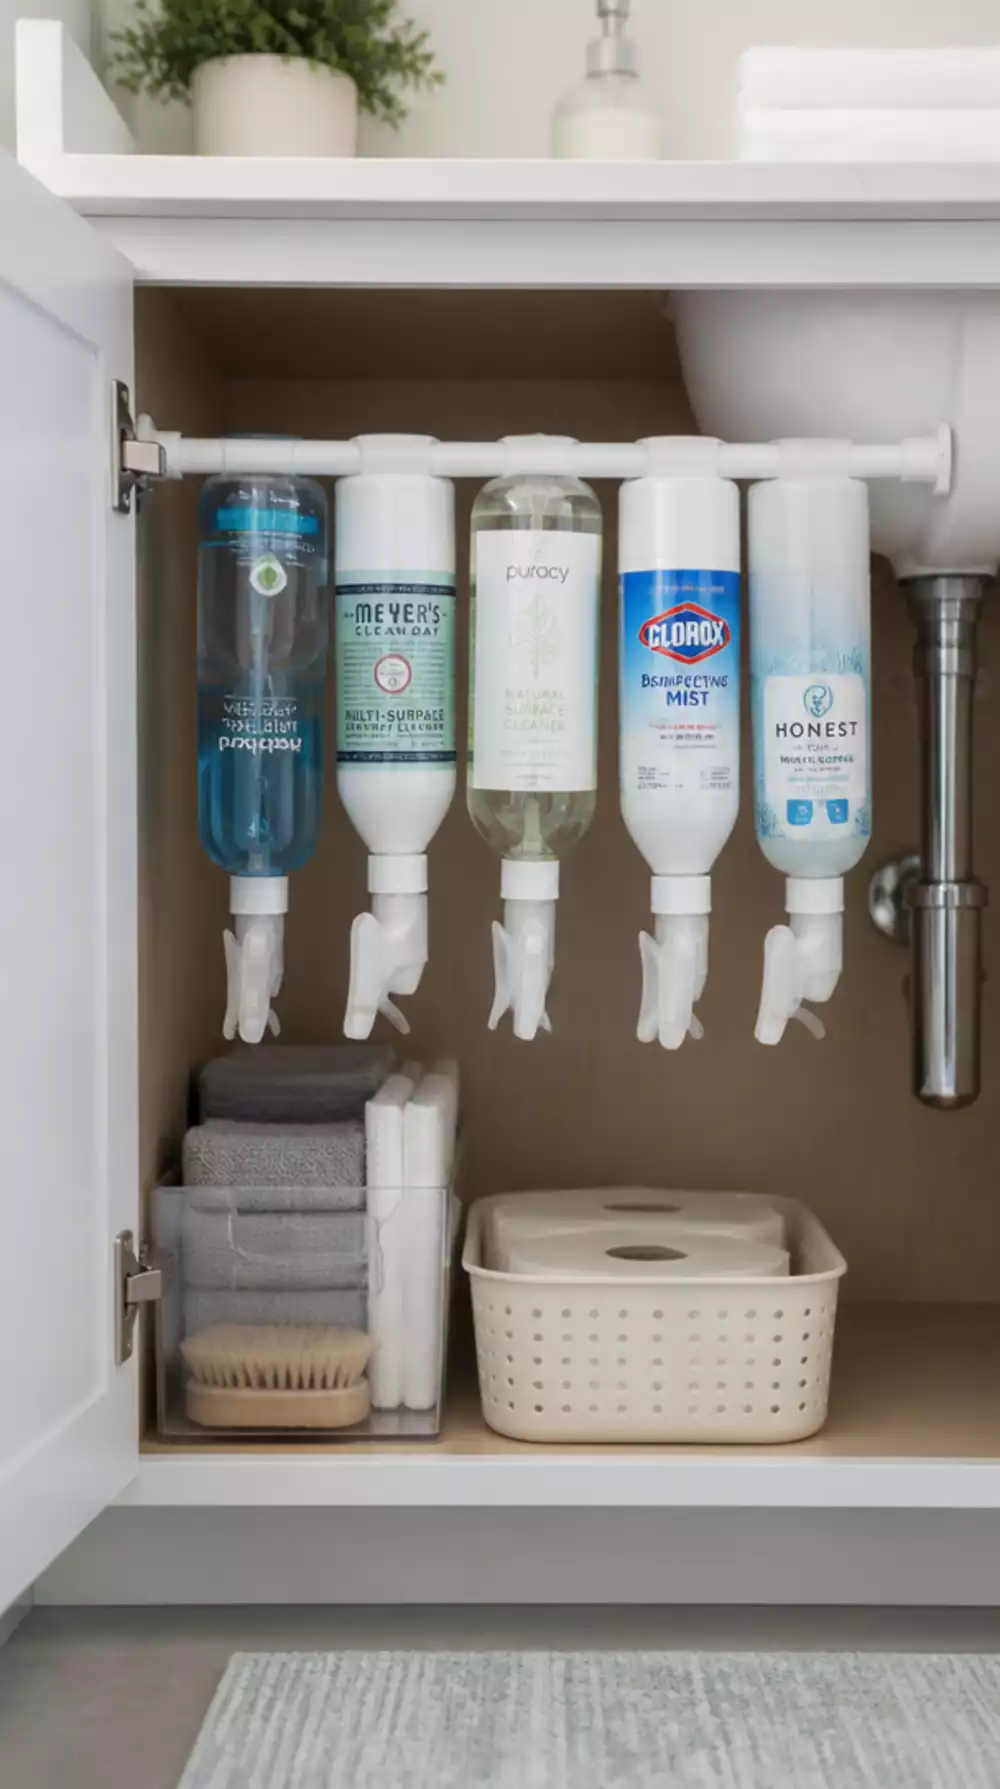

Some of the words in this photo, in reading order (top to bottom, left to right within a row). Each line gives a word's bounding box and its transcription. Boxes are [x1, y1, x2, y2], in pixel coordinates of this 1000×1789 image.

[506, 564, 570, 583] puracy
[355, 602, 440, 624] MEYER'S
[648, 621, 725, 648] CLOROX
[666, 690, 709, 706] MIST
[776, 721, 858, 738] HONEST
